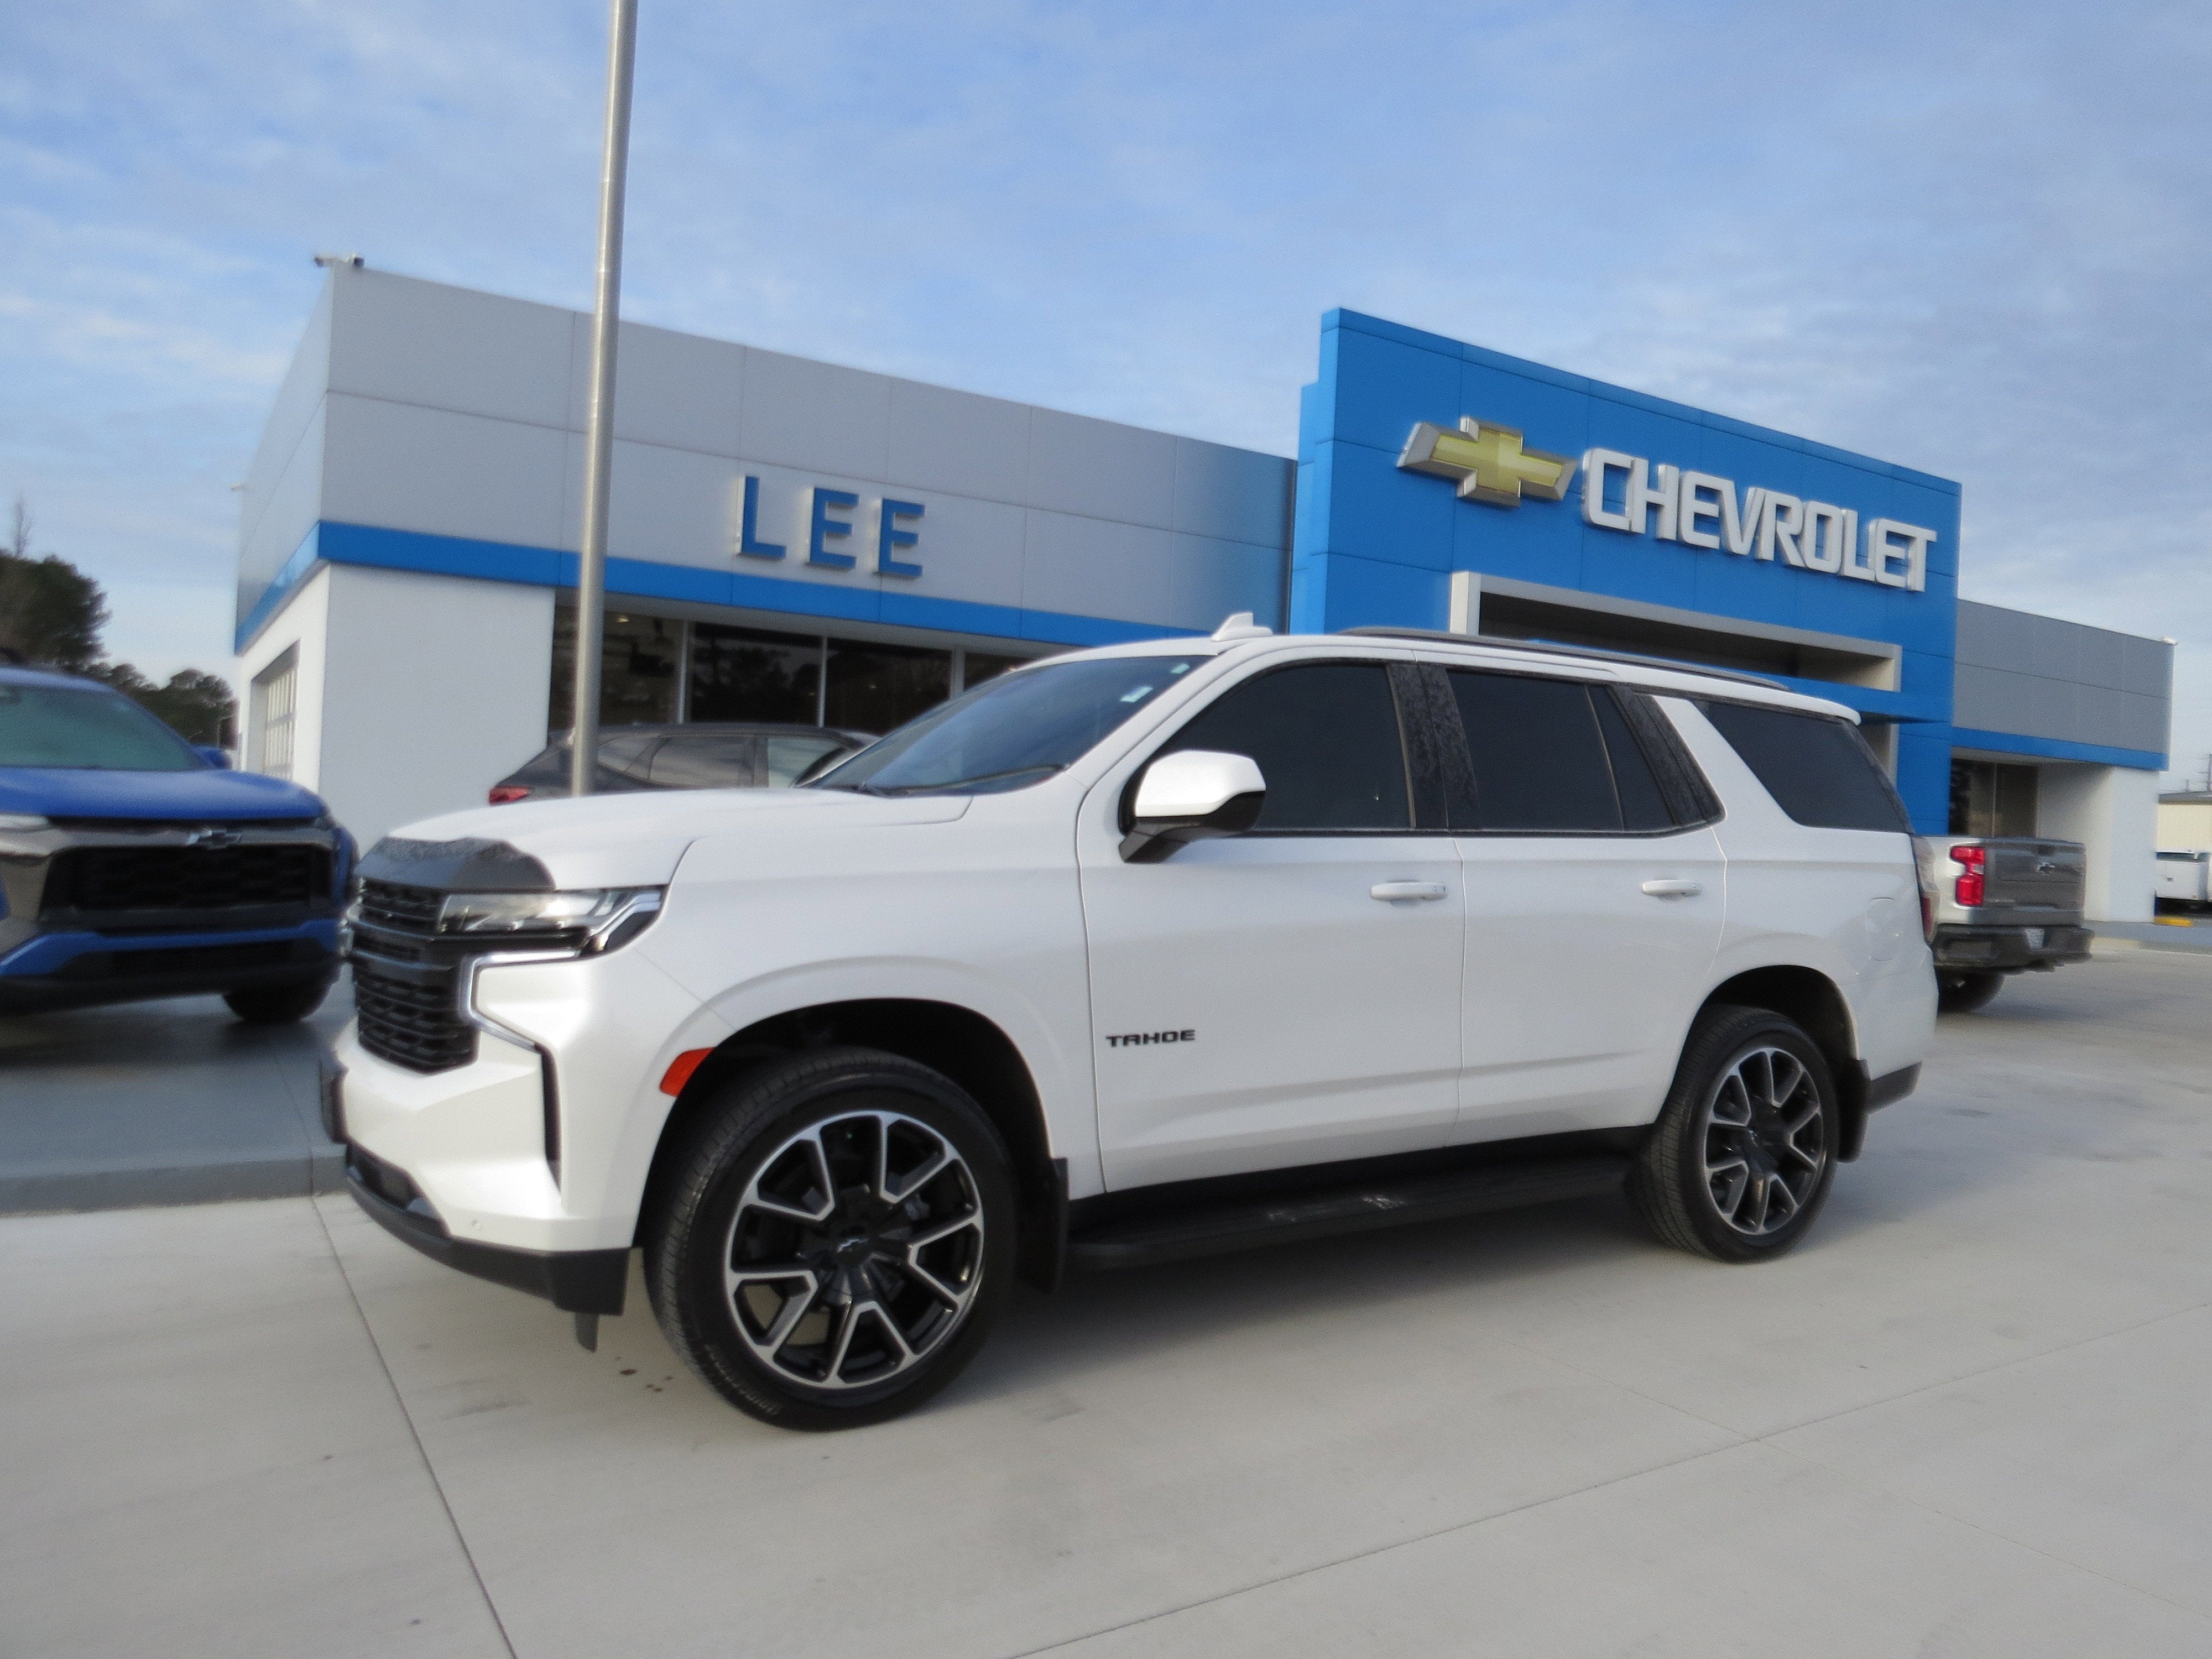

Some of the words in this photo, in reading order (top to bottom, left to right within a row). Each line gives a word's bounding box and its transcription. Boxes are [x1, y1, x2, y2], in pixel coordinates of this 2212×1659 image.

[738, 475, 926, 578] LEE
[1581, 448, 1937, 592] CHEVROLET
[1105, 1029, 1196, 1048] TAHOE
